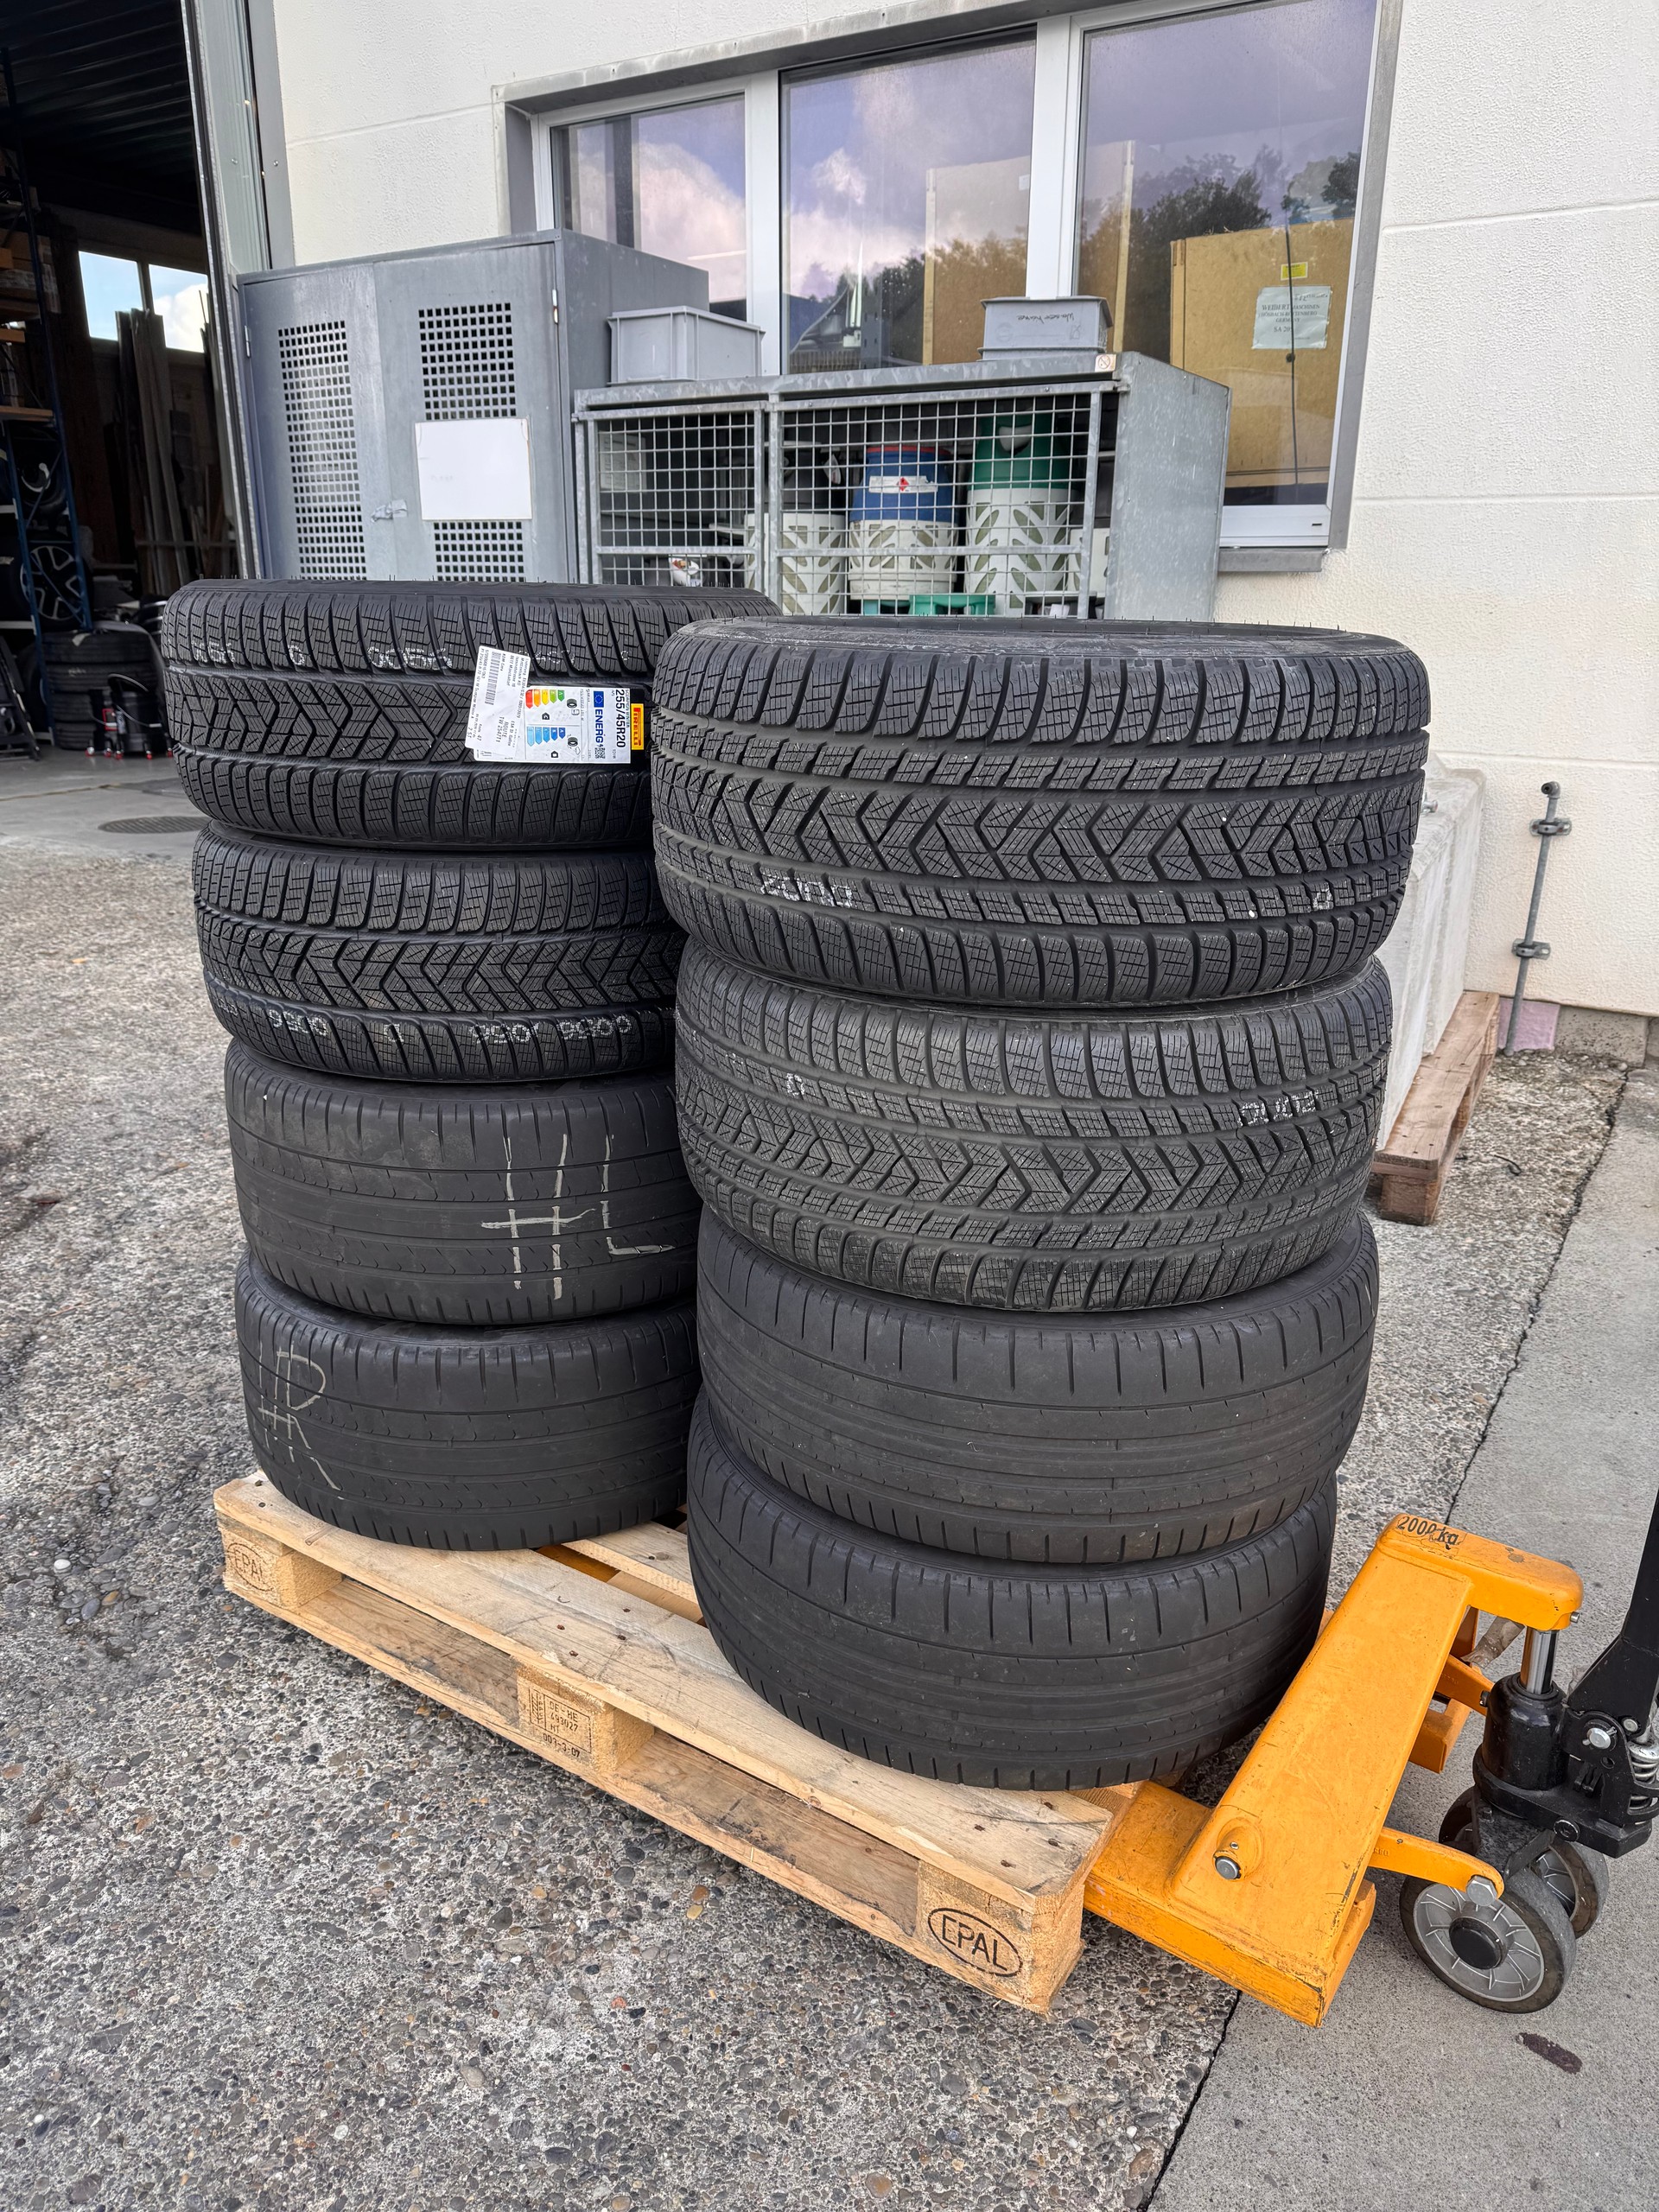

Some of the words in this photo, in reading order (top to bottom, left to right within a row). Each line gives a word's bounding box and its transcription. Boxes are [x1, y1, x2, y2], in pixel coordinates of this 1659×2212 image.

[594, 709, 604, 743] ENERG
[613, 689, 626, 747] 255/45R20
[632, 707, 642, 746] PIRELLI
[1397, 1516, 1437, 1535] 2000
[942, 1914, 1007, 1972] EPAL
